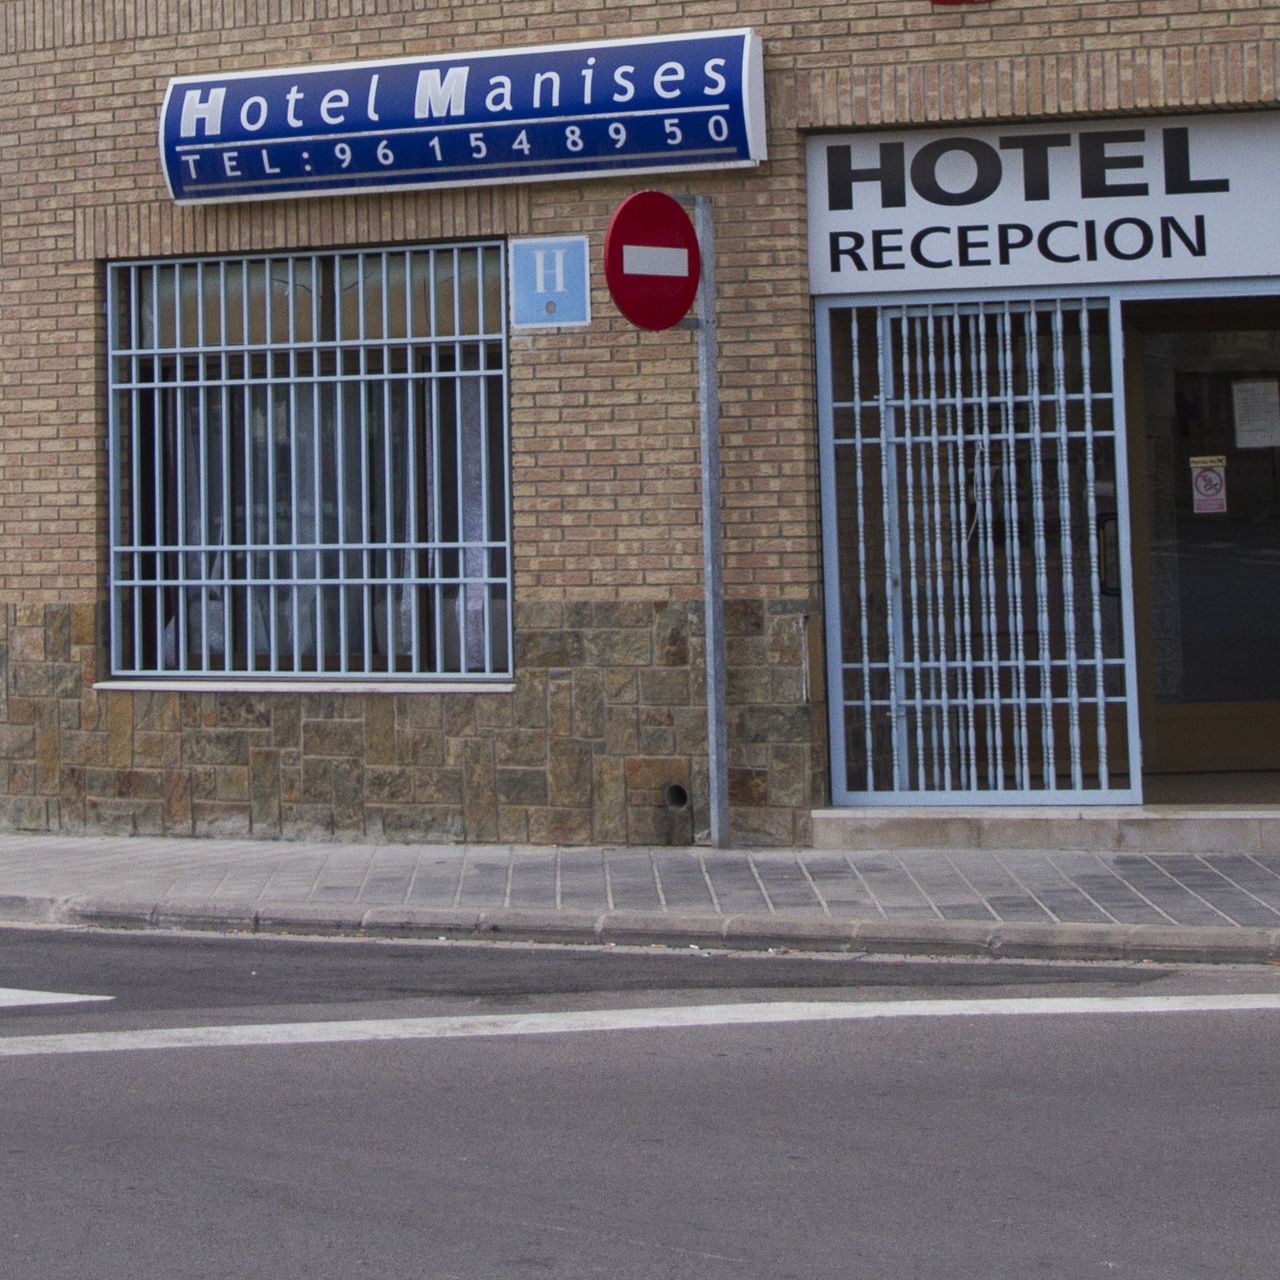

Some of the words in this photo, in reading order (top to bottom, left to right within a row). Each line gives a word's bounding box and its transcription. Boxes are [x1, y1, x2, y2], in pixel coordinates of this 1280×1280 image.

[180, 74, 379, 138] Hotel
[414, 55, 727, 120] Manises
[826, 126, 1230, 211] HOTEL
[829, 215, 1207, 272] RECEPCION
